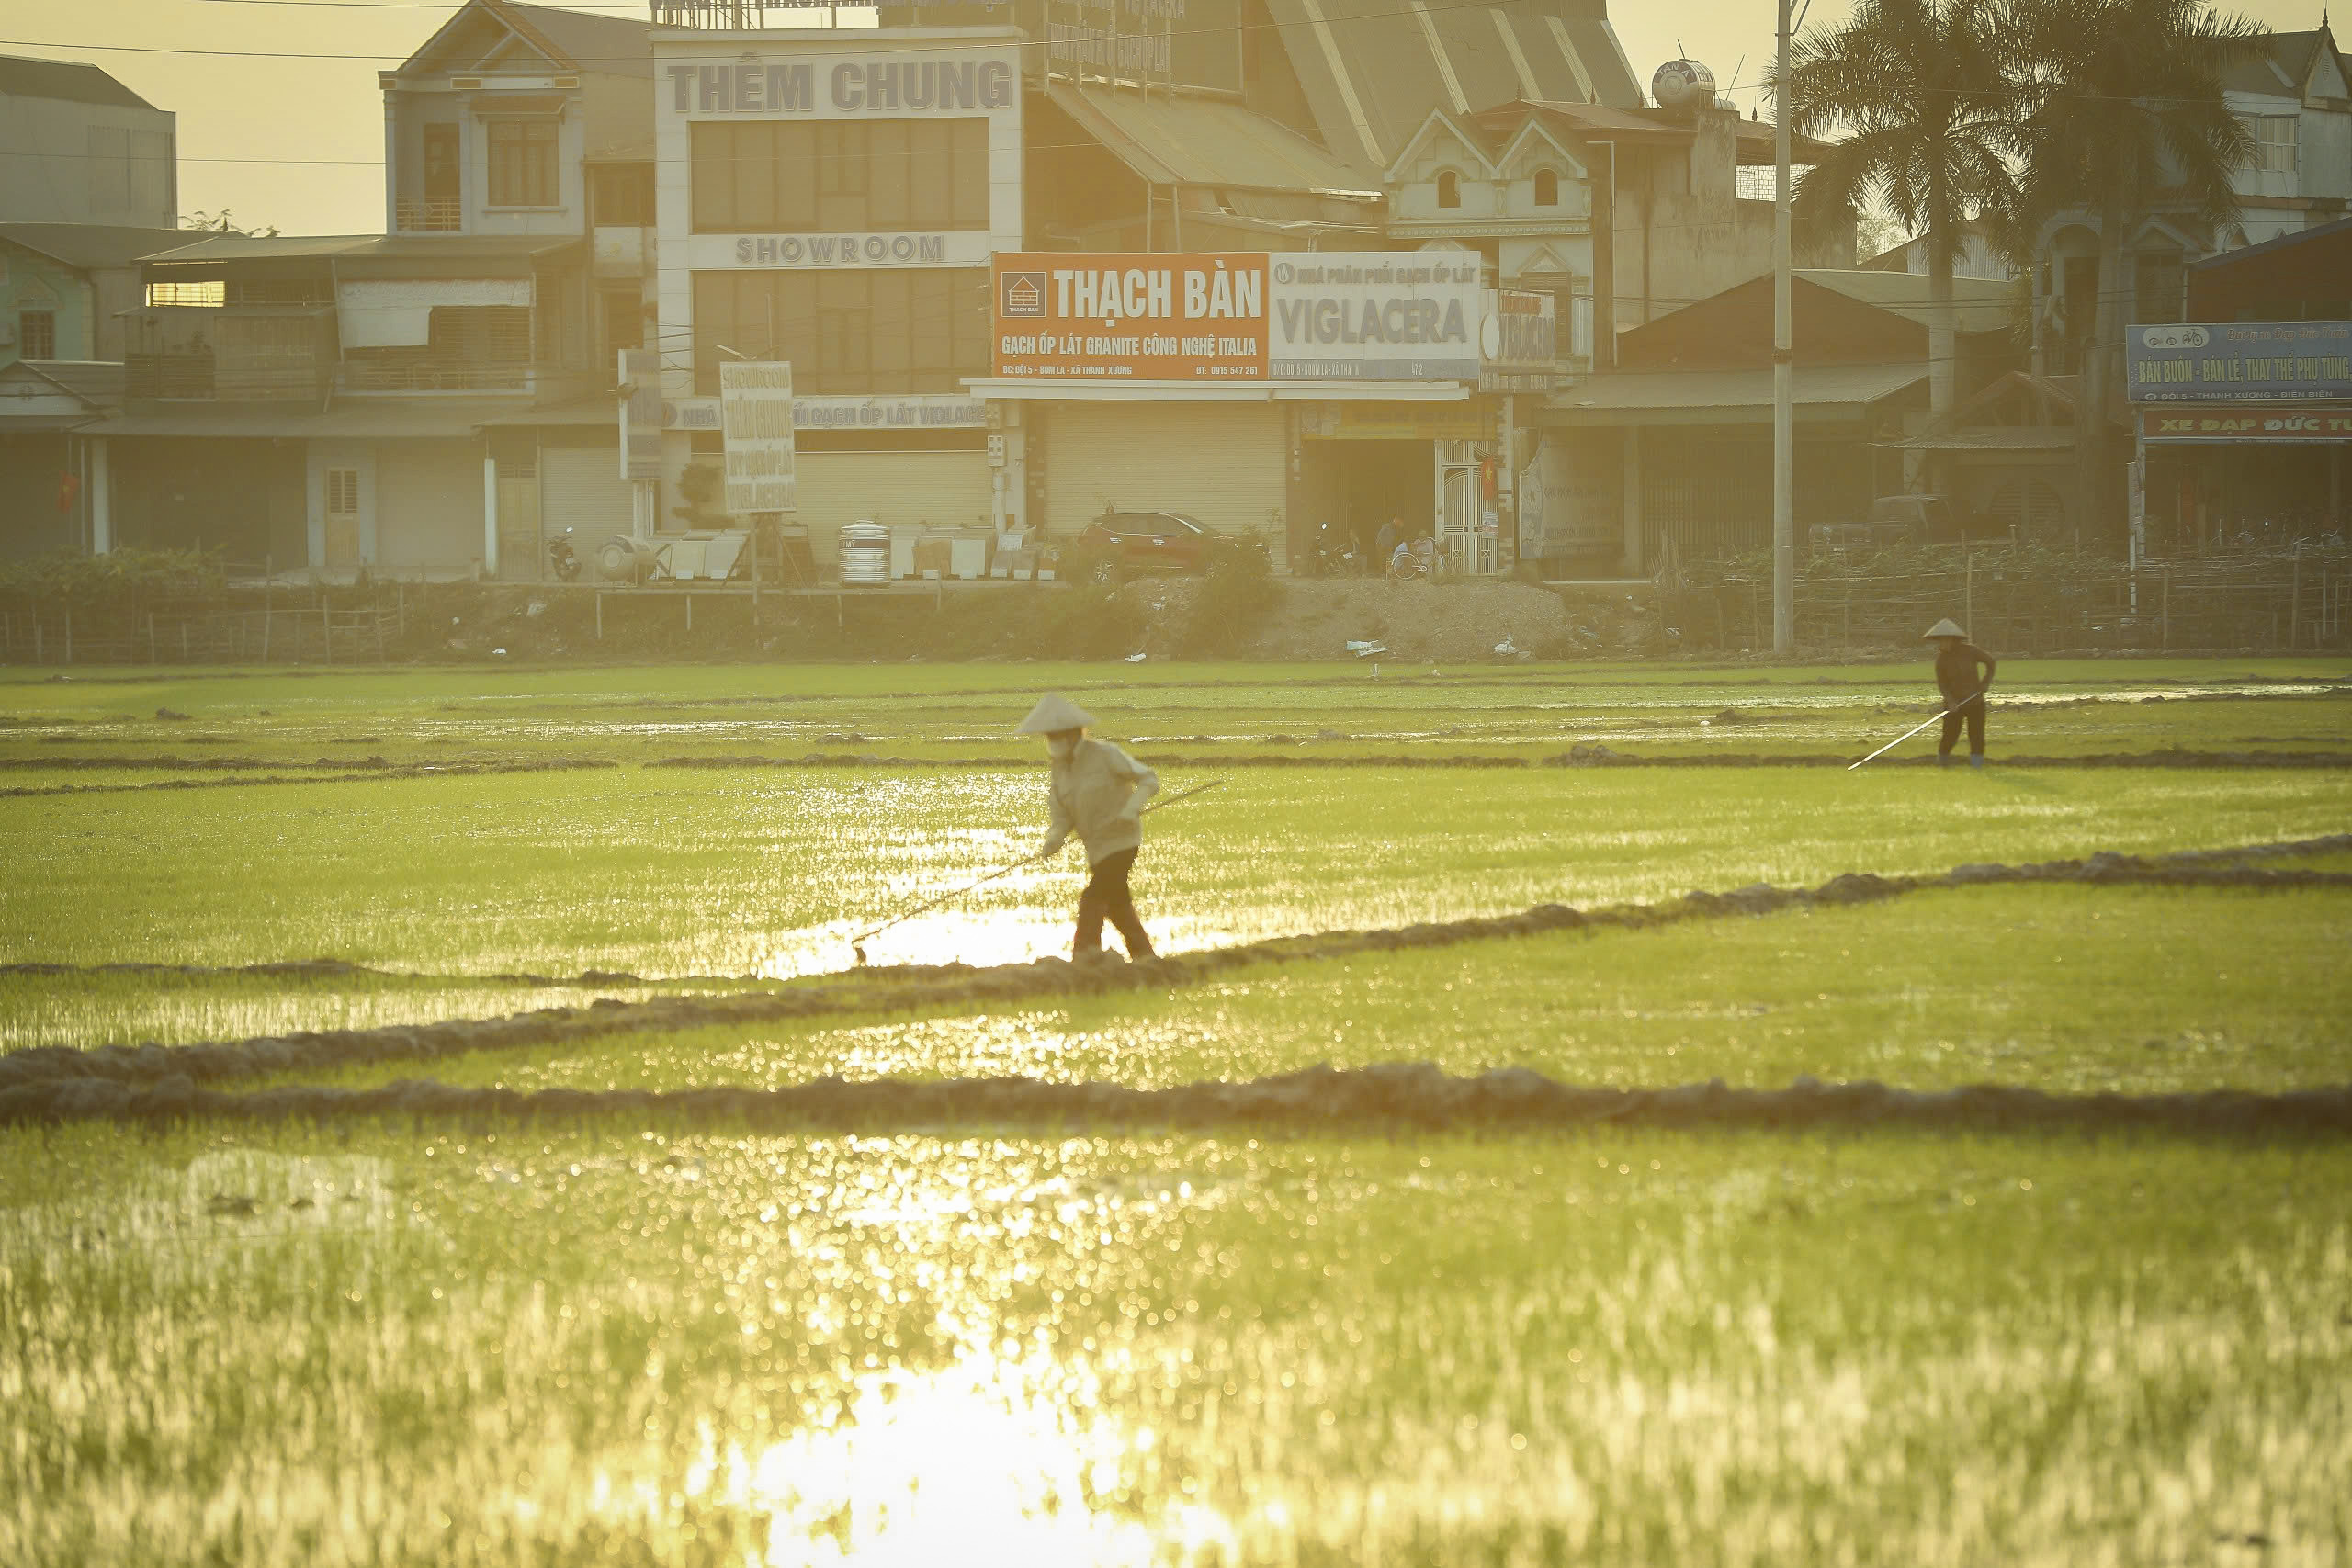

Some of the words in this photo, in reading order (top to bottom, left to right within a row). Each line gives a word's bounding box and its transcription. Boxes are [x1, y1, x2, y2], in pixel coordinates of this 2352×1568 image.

[831, 60, 1012, 111] CHUNG
[736, 235, 944, 265] SHOWROOM
[1053, 268, 1172, 327] THẠCH
[1183, 259, 1261, 319] BÀN
[1276, 297, 1468, 344] VIGLACERA
[1001, 336, 1035, 358] GẠCH
[1039, 330, 1056, 355] ỐP
[1059, 333, 1082, 355] LÁT
[1086, 337, 1139, 355] GRANITE
[1143, 333, 1177, 355] CÔNG
[1182, 334, 1215, 358] NGHỆ
[1218, 337, 1257, 355] ITALIA
[1056, 365, 1065, 375] LA
[1082, 366, 1105, 375] THANH
[1211, 366, 1227, 375] 0915
[1230, 367, 1243, 375] 547
[1246, 367, 1258, 375] 261
[2139, 355, 2161, 382] BÁN
[2164, 355, 2193, 382] BUÔN
[2202, 355, 2225, 382] BÁN
[2245, 359, 2271, 382] THAY
[2274, 351, 2294, 382] THẾ
[2296, 356, 2318, 385] PHỤ
[811, 405, 855, 428] GẠCH
[860, 399, 883, 426] ỐP
[2159, 419, 2194, 431] XE
[2200, 419, 2257, 434] ĐẠP
[2264, 415, 2321, 431] ĐỨC
